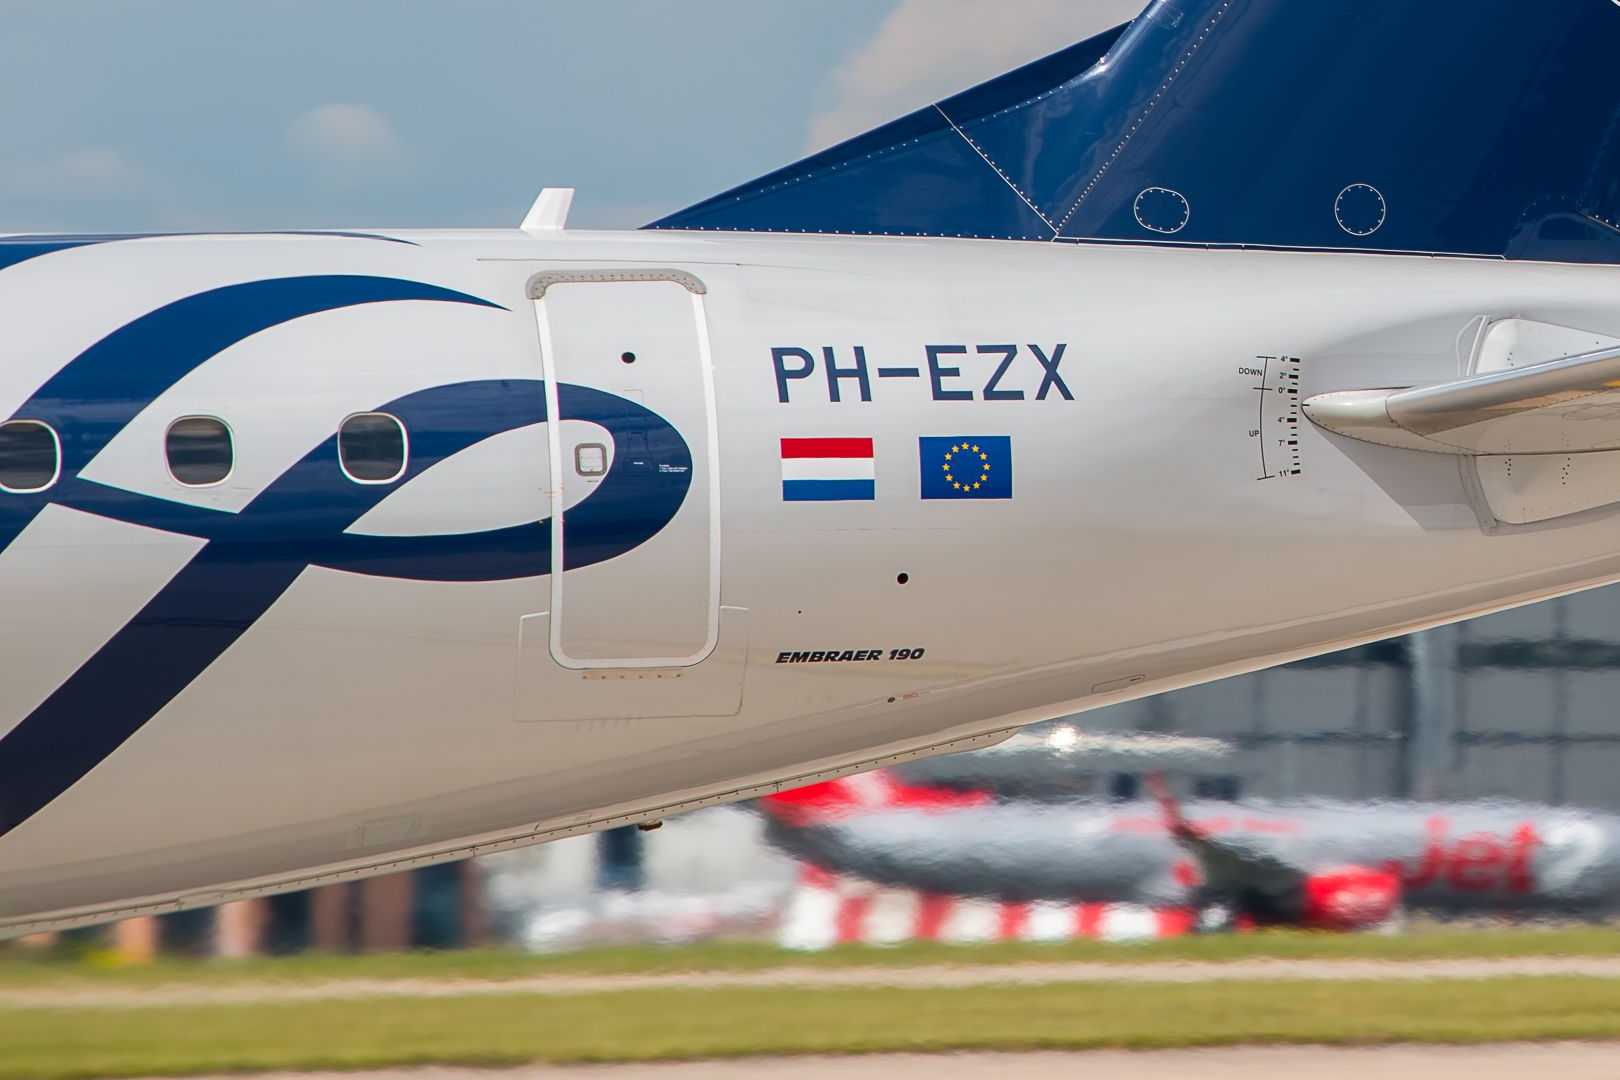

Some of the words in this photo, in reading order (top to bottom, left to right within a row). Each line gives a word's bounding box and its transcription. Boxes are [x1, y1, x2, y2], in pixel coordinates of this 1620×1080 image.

[770, 343, 1076, 403] PH-EZX
[1238, 367, 1263, 376] DOWN
[1248, 429, 1260, 437] UP
[775, 650, 883, 664] EMBRAER
[888, 648, 925, 660] 190
